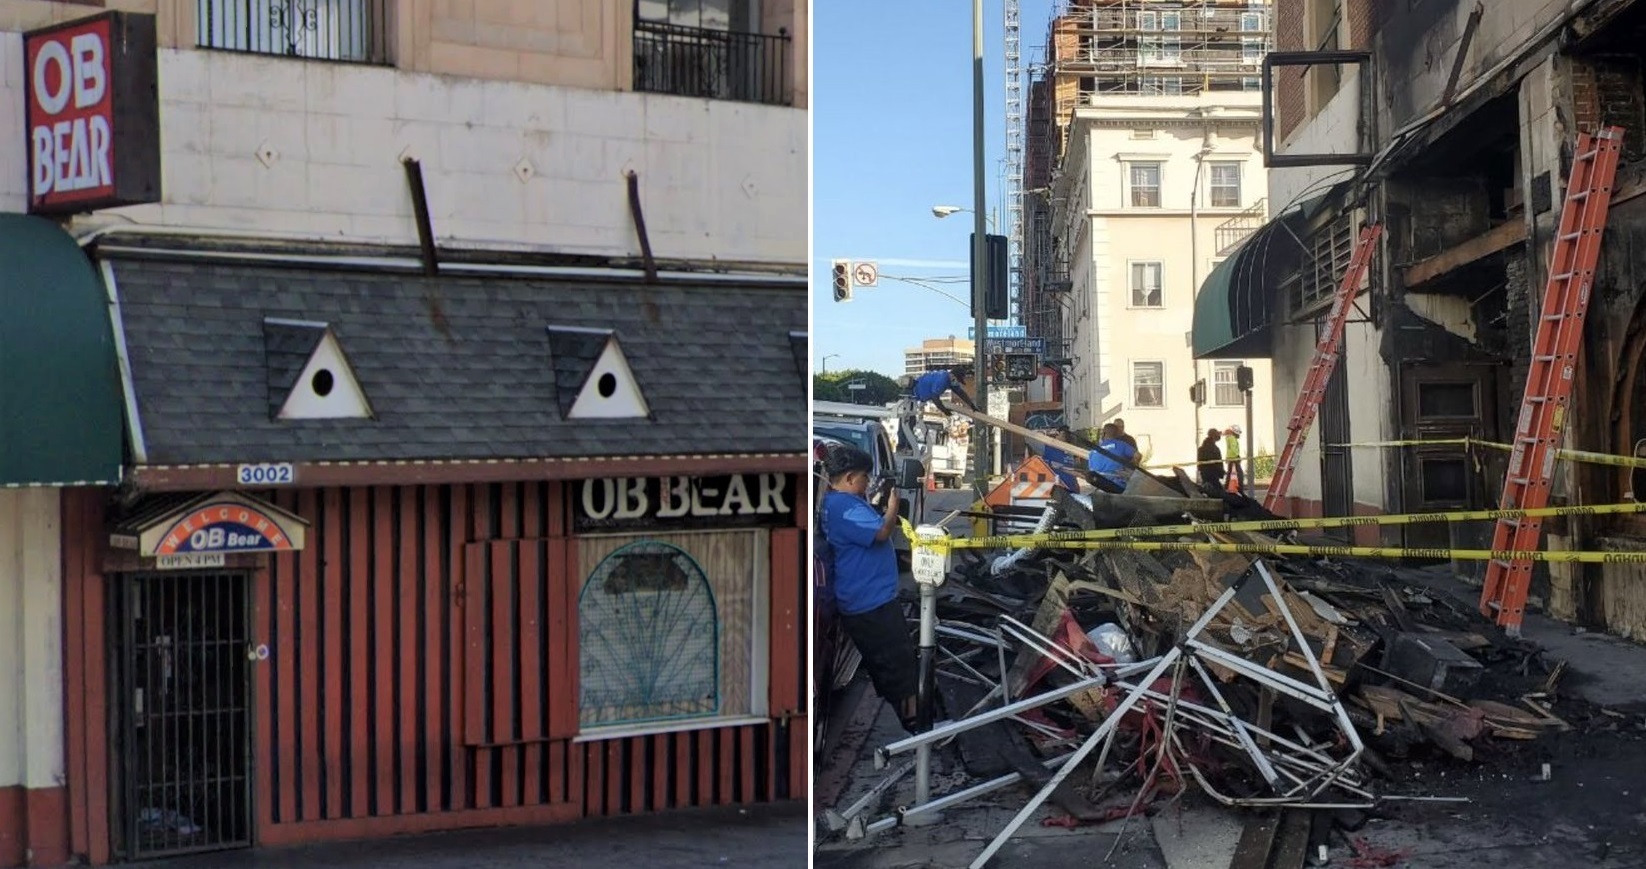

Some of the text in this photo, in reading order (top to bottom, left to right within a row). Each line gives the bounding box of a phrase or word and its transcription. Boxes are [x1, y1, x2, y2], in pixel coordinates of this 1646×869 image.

[33, 32, 107, 115] OB
[32, 115, 112, 196] BEAR
[241, 467, 290, 482] 3002
[582, 472, 791, 520] OB BEAR
[167, 508, 283, 548] WELCOME
[1193, 523, 1231, 534] CAUTION
[1260, 520, 1300, 530] CUIDADO
[1340, 517, 1379, 527] CAUTION
[1408, 514, 1448, 523] CUIDADO
[1489, 510, 1527, 520] CAUTION
[1555, 506, 1596, 516] CUIDADO
[190, 527, 262, 550] OB Bear
[161, 554, 193, 567] OPEN
[204, 554, 221, 565] PM
